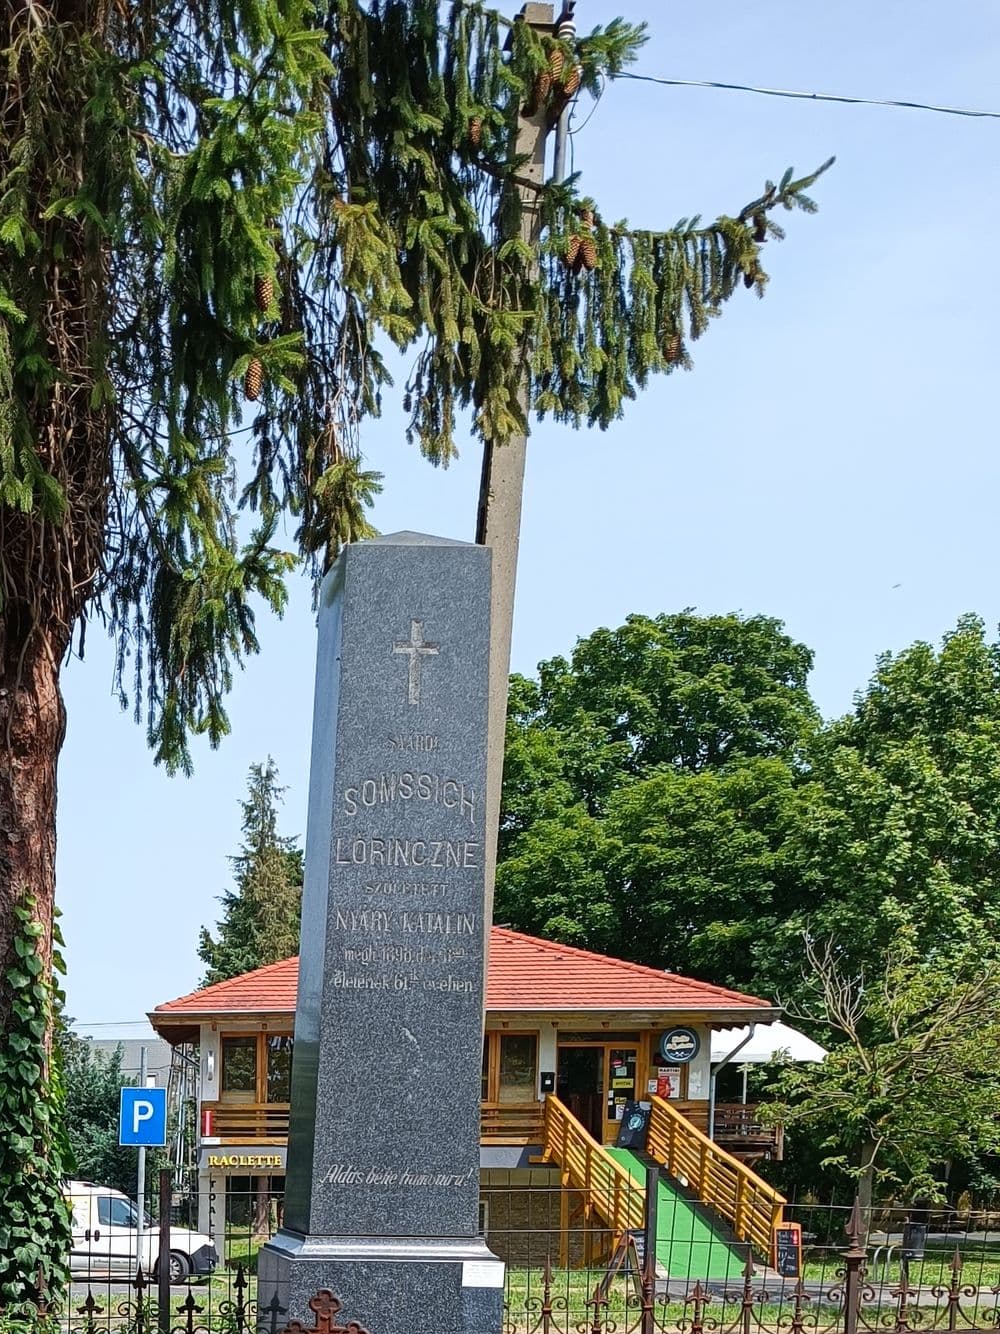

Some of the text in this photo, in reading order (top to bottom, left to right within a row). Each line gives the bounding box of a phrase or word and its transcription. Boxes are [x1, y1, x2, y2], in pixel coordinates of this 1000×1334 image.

[343, 772, 476, 825] SOMSSICH
[400, 911, 476, 935] KATALIN
[133, 1100, 154, 1133] P
[209, 1155, 282, 1166] RACLETTE
